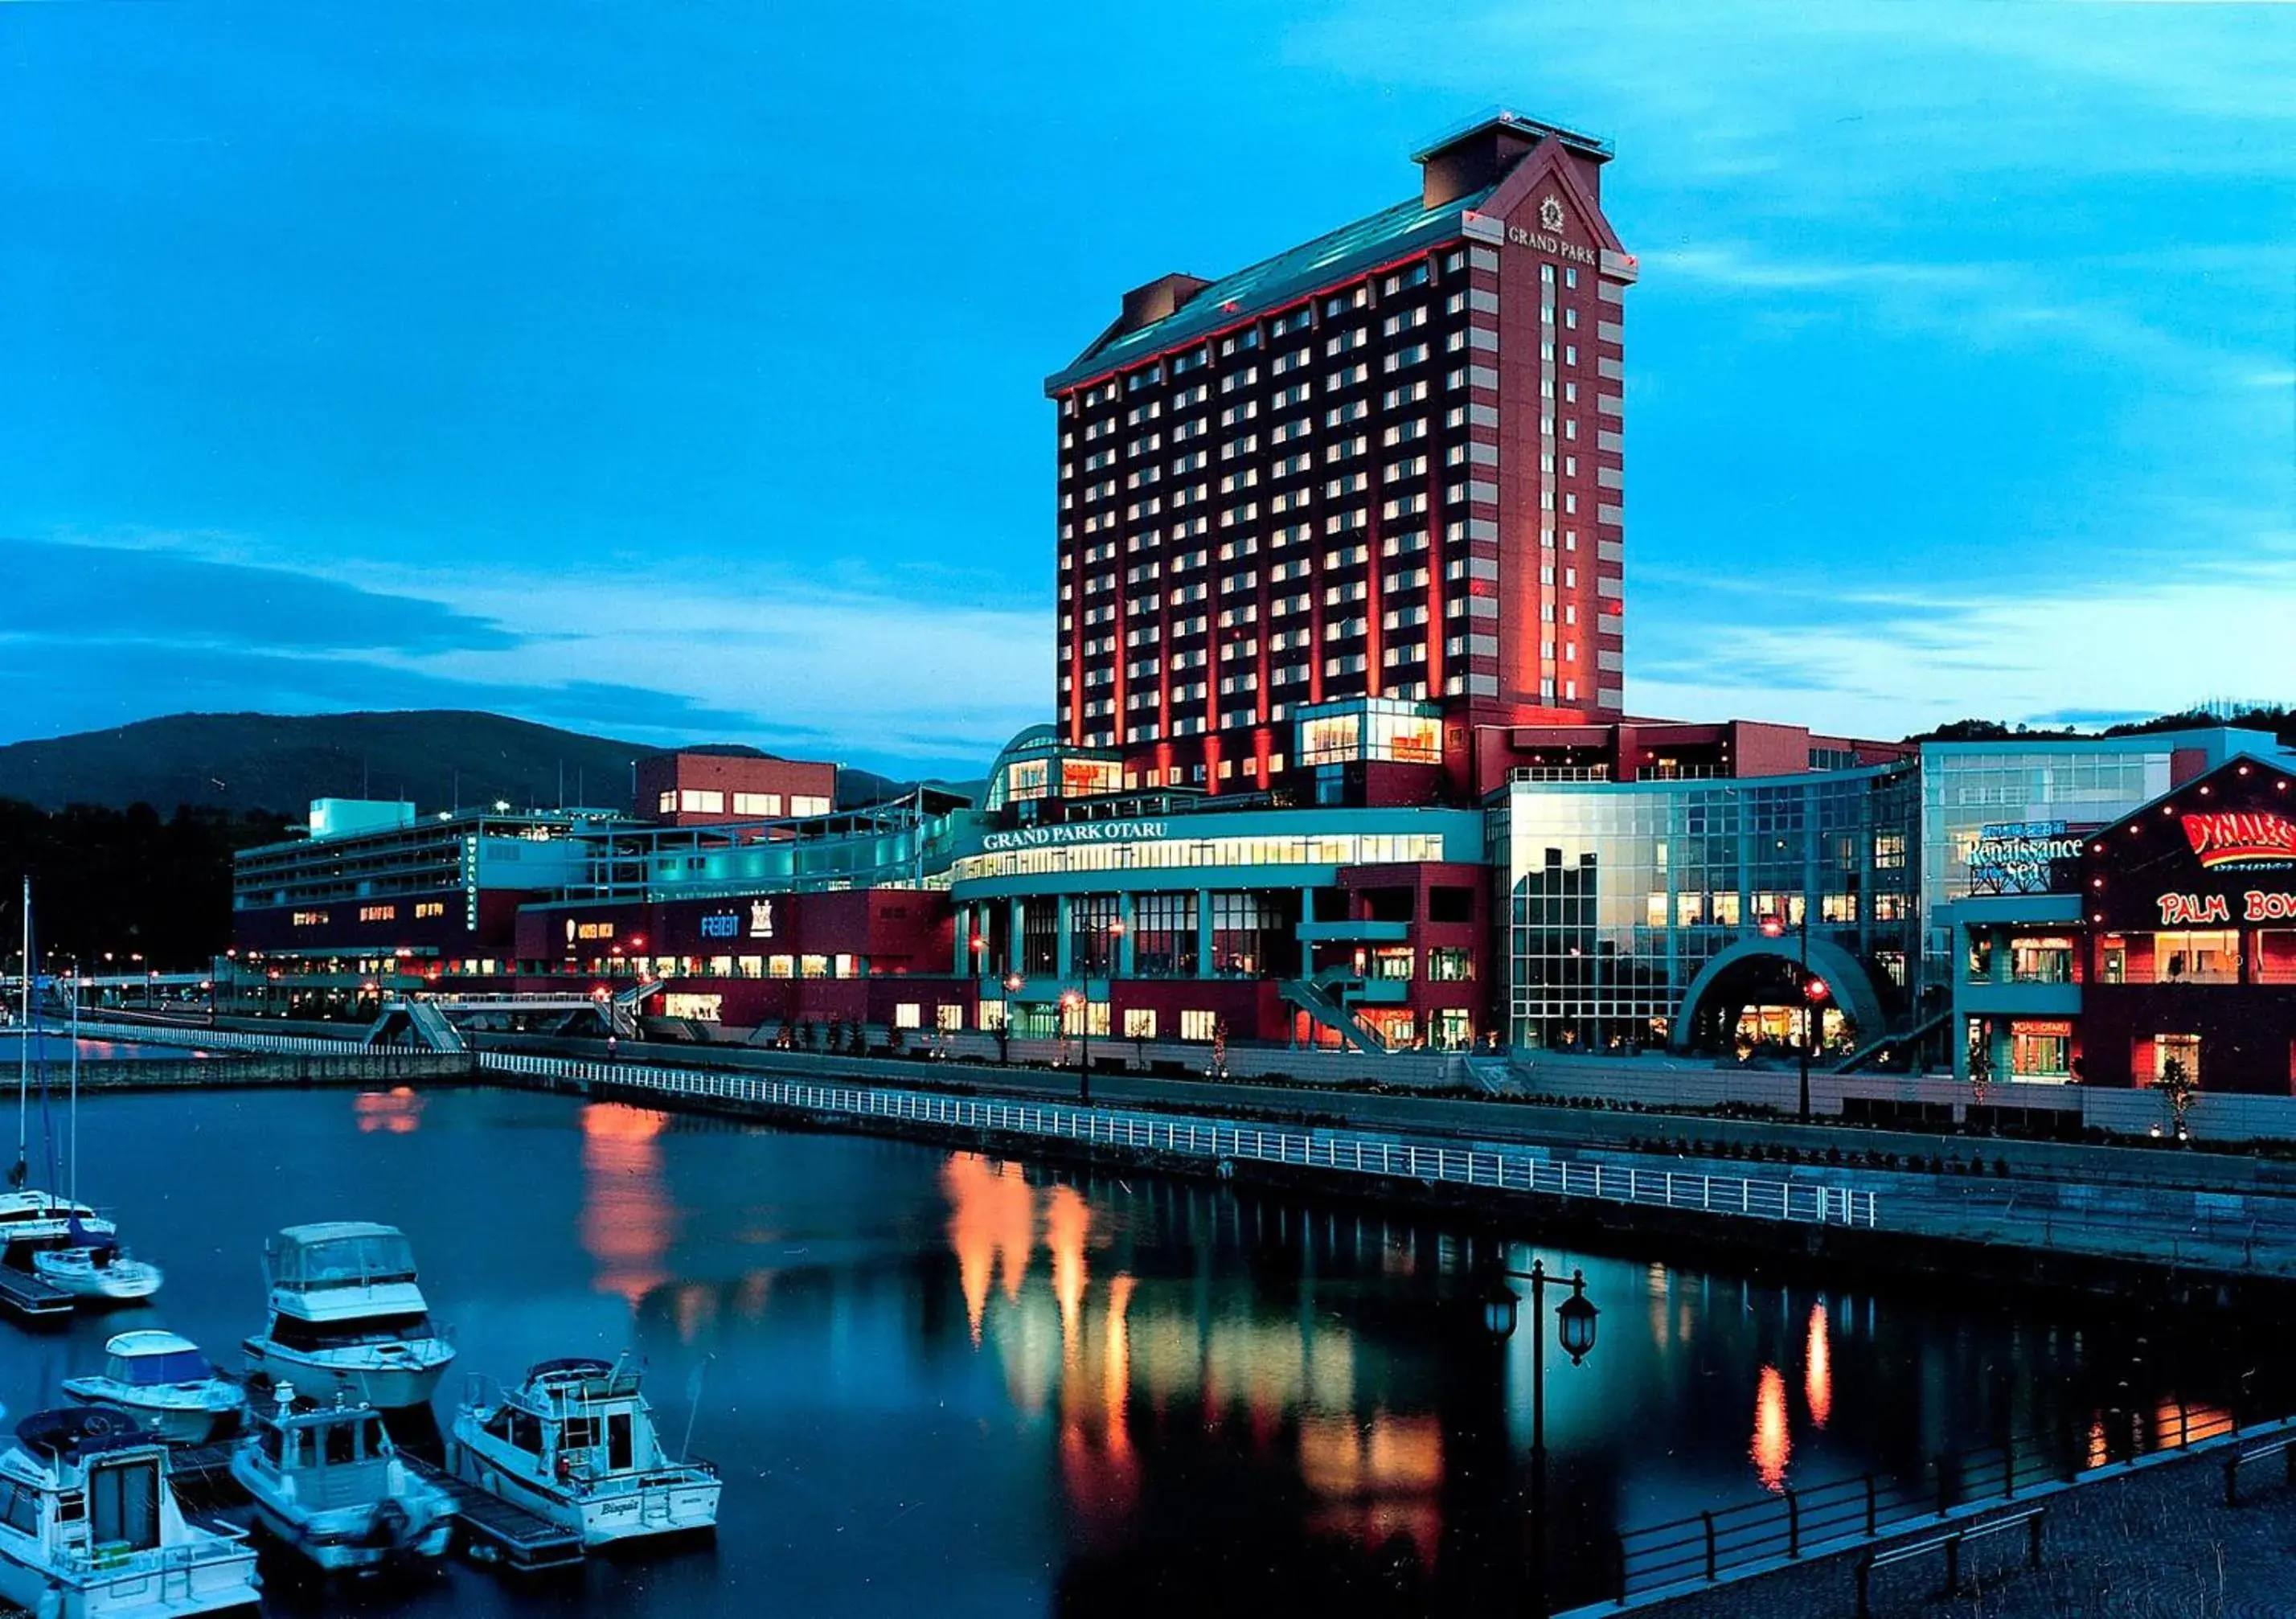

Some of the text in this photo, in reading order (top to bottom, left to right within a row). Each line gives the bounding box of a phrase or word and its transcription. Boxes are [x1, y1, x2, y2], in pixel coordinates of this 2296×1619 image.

[1508, 226, 1596, 265] GRAND PARK
[983, 822, 1168, 850] GRAND PARK OTARU
[1966, 838, 2084, 865] Renaissance
[2007, 862, 2040, 880] Sea
[2157, 892, 2230, 925] PALM
